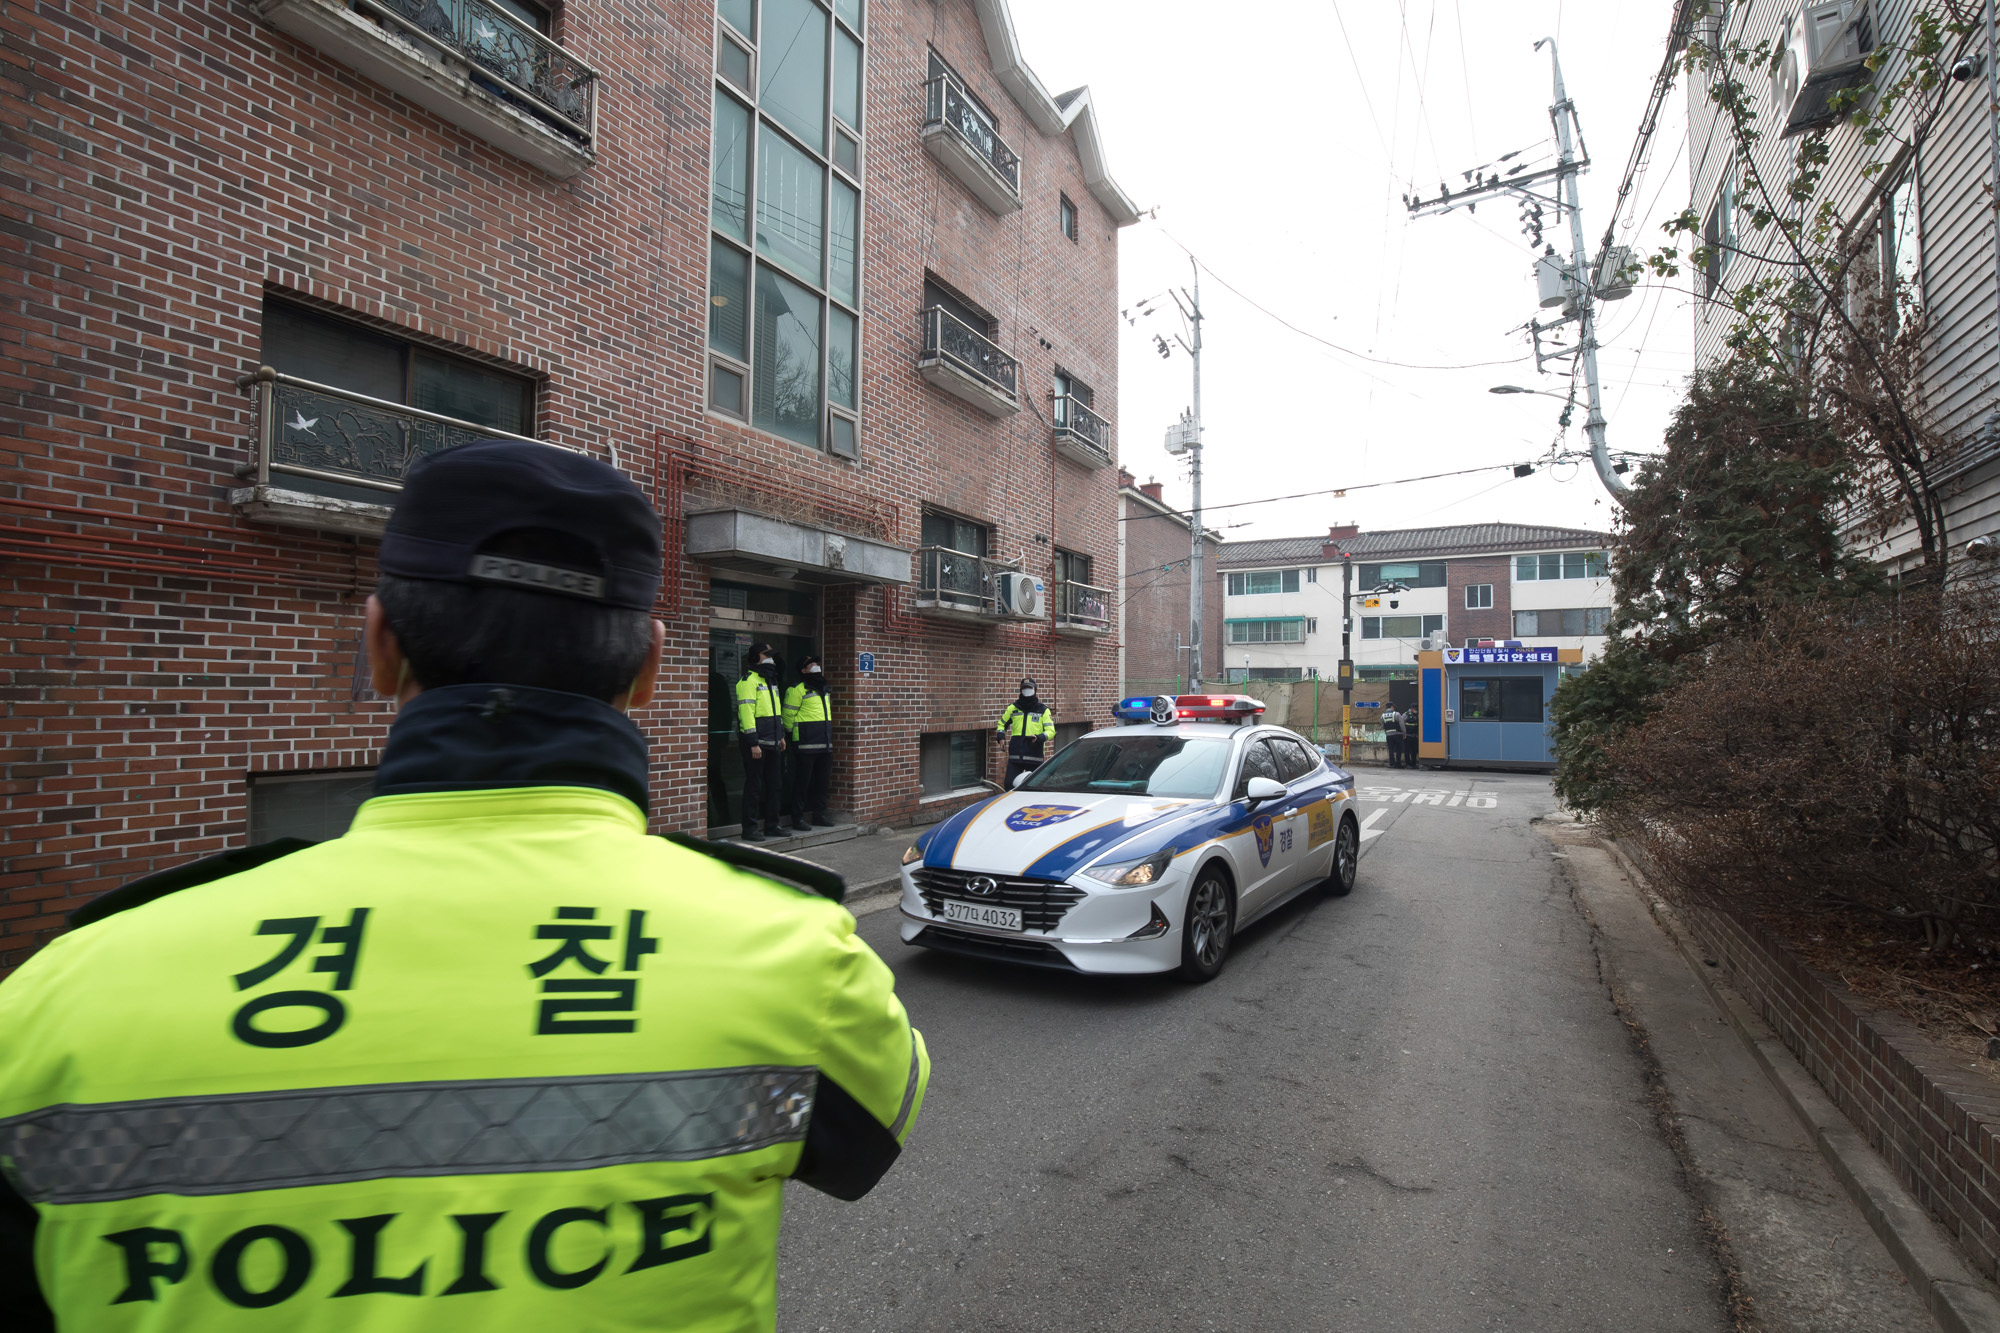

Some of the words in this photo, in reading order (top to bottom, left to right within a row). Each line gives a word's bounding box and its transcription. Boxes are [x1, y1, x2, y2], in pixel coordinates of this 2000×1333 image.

[864, 661, 869, 670] 2
[1469, 653, 1553, 662] 특별치안센터
[1280, 827, 1293, 853] 경찰
[982, 909, 1017, 928] 4032
[101, 1192, 716, 1309] POLICE
